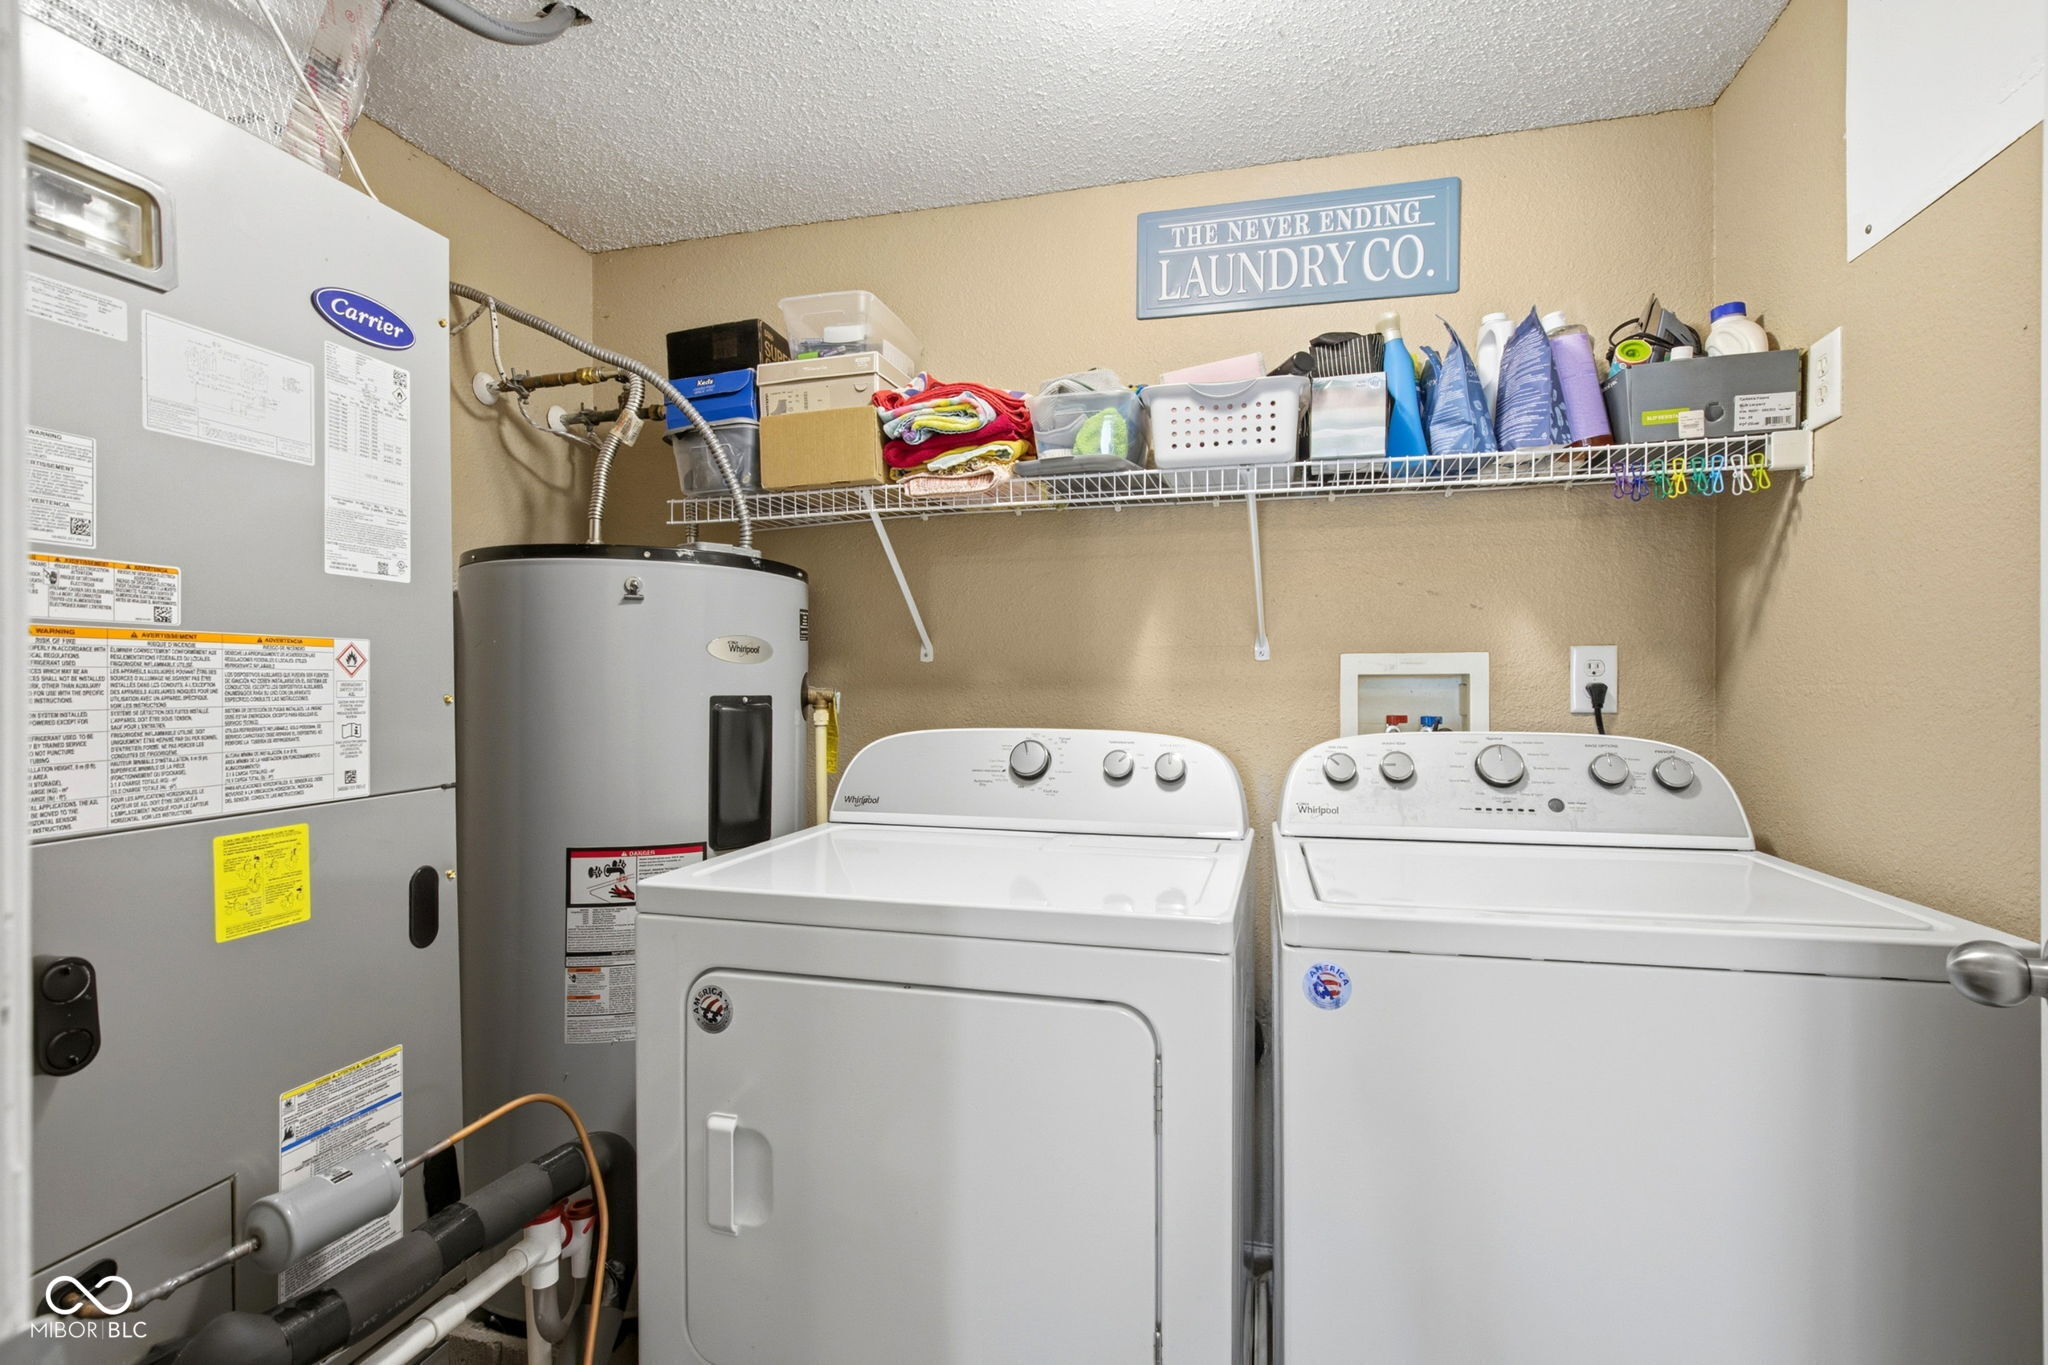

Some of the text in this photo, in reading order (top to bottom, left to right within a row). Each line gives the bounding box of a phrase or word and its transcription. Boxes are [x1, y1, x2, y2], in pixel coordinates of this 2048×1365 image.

[1171, 201, 1421, 248] THE NEVER ENDING
[1158, 234, 1435, 301] LAUNDRY CO.
[330, 298, 404, 338] Carrier
[696, 378, 714, 386] Keds
[728, 643, 760, 657] Whirlpool
[844, 794, 880, 807] Whirlpool
[1297, 805, 1339, 816] Whirlpool
[1310, 965, 1349, 986] AMERICA
[693, 988, 723, 1014] AMERICA
